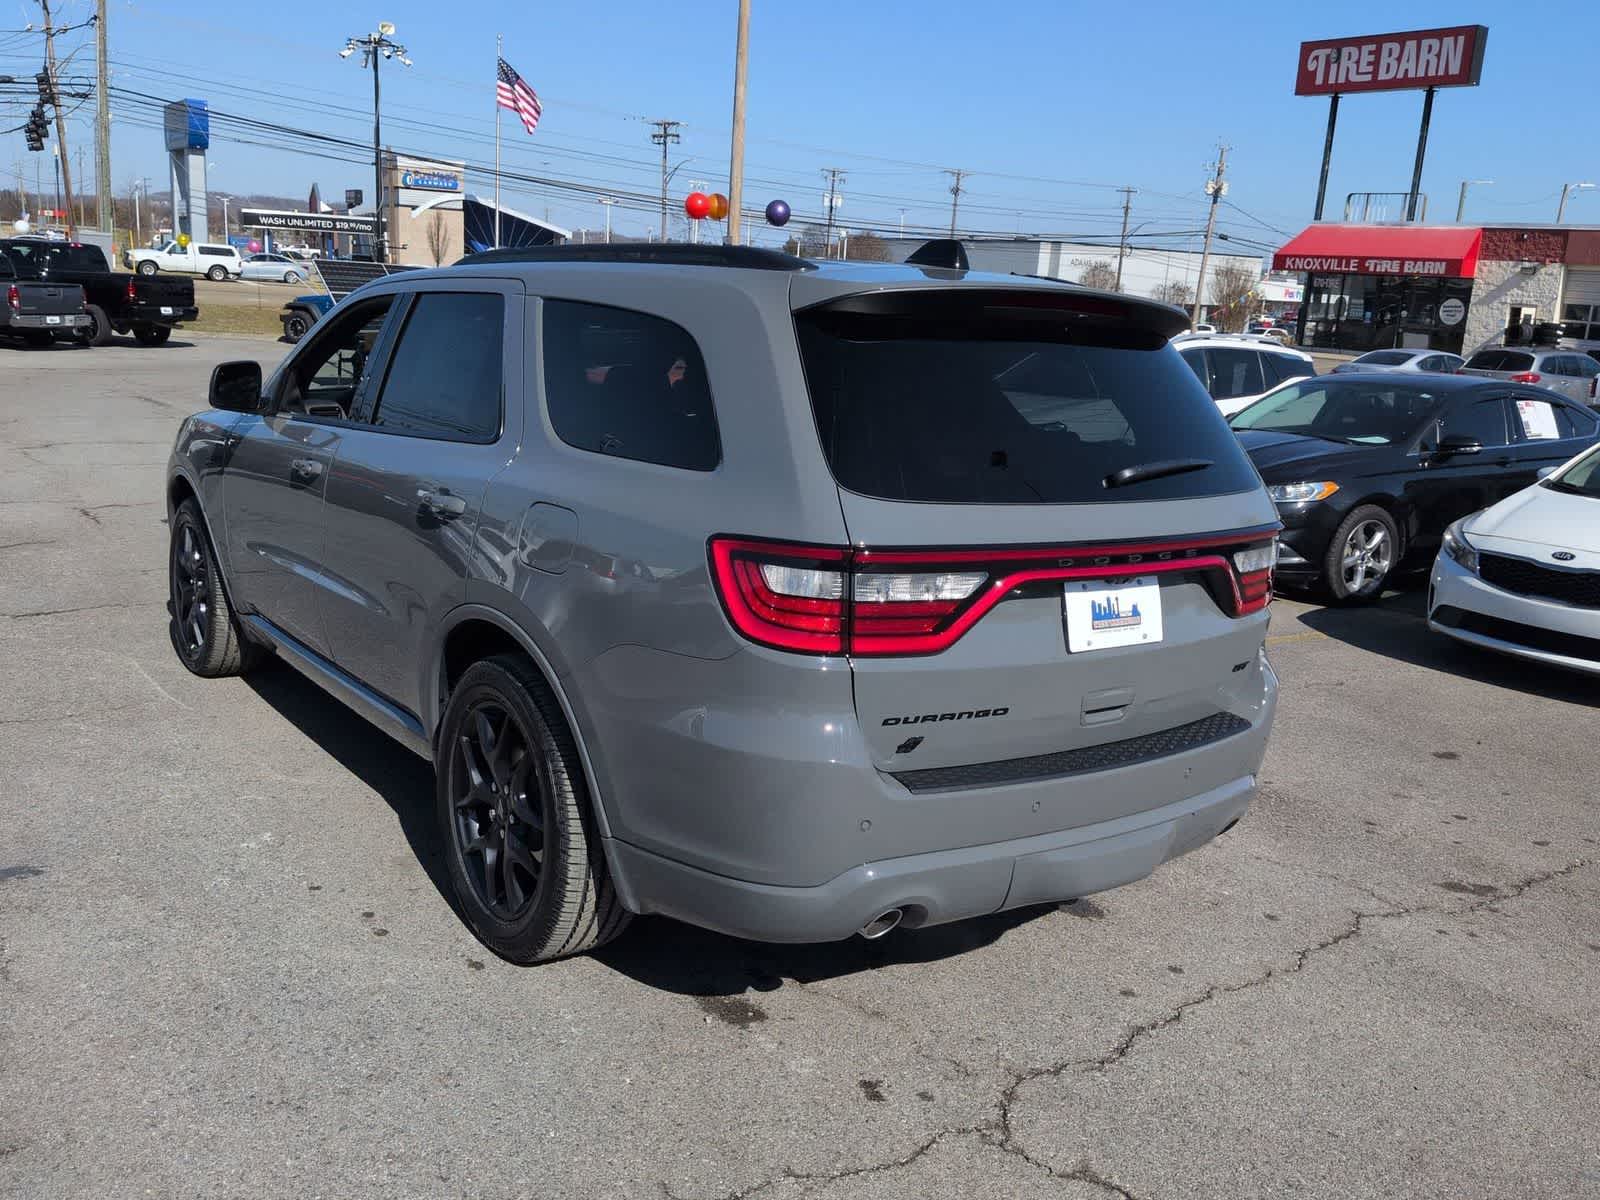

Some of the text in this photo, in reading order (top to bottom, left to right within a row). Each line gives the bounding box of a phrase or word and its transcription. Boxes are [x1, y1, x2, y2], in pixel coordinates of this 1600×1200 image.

[1377, 35, 1465, 81] BARN
[259, 216, 372, 232] WASH UNLIMITED $19.99/mo
[1285, 257, 1358, 271] KNOXVILLE
[1403, 261, 1447, 275] BARN
[1058, 549, 1197, 567] DODGE
[881, 707, 1009, 726] DURANGO
